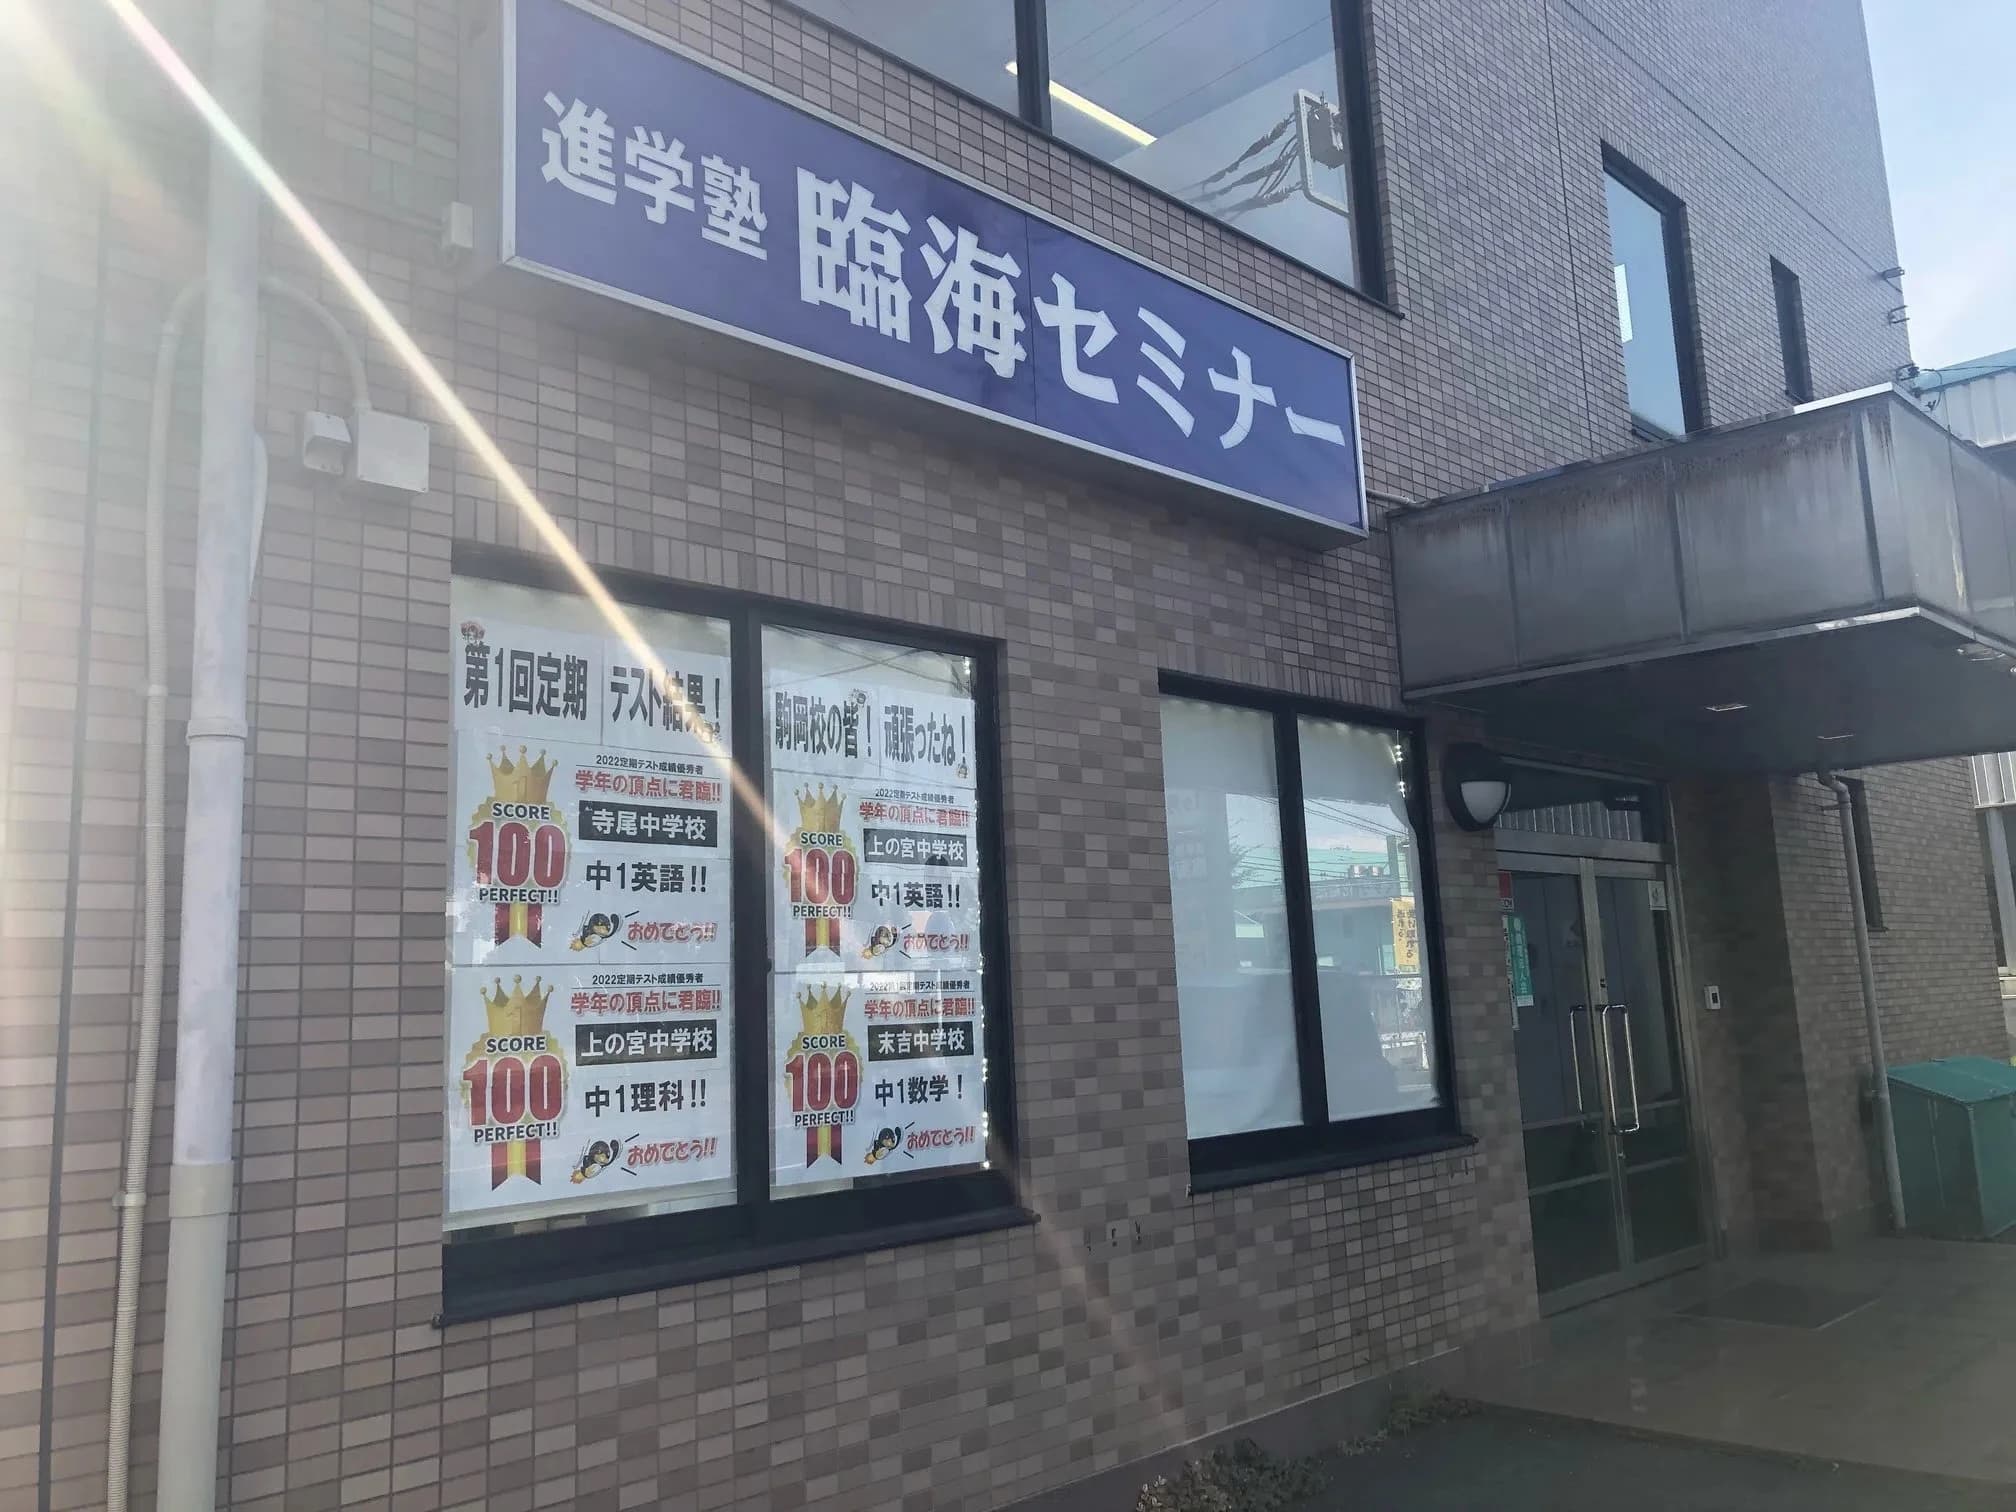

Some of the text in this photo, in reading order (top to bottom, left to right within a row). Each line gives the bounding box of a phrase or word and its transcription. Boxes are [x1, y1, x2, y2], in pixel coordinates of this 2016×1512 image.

[541, 90, 1345, 449] 進学塾 臨海セミナー
[464, 643, 588, 721] 第1回定期
[884, 703, 966, 766] 頑張ったね!
[575, 769, 721, 801] 学年の頂点に君臨!!
[492, 803, 550, 820] SCORE
[592, 808, 706, 840] 寺尾中学校
[800, 832, 843, 847] SCORE
[868, 835, 964, 861] 上の宮中学校
[469, 821, 567, 889] 100
[585, 860, 708, 893] 中1英語!!
[784, 848, 856, 905] 100
[479, 888, 559, 904] PERFECT!!
[871, 880, 960, 908] 中1英語!!
[793, 905, 851, 919] PERFECT!!
[570, 989, 721, 1015] 学年の頂点に君臨!!
[486, 1036, 546, 1053] SCORE
[580, 1028, 713, 1058] 上の宮中学校
[802, 1035, 846, 1050] SCORE
[878, 1028, 965, 1055] 末吉中学校
[463, 1054, 562, 1127] 100
[785, 1051, 858, 1112] 100
[875, 1074, 963, 1107] 中1数学!
[585, 1079, 707, 1118] 中1理科!!
[474, 1122, 558, 1143] PERFECT!!
[794, 1110, 854, 1127] PERFECT!!
